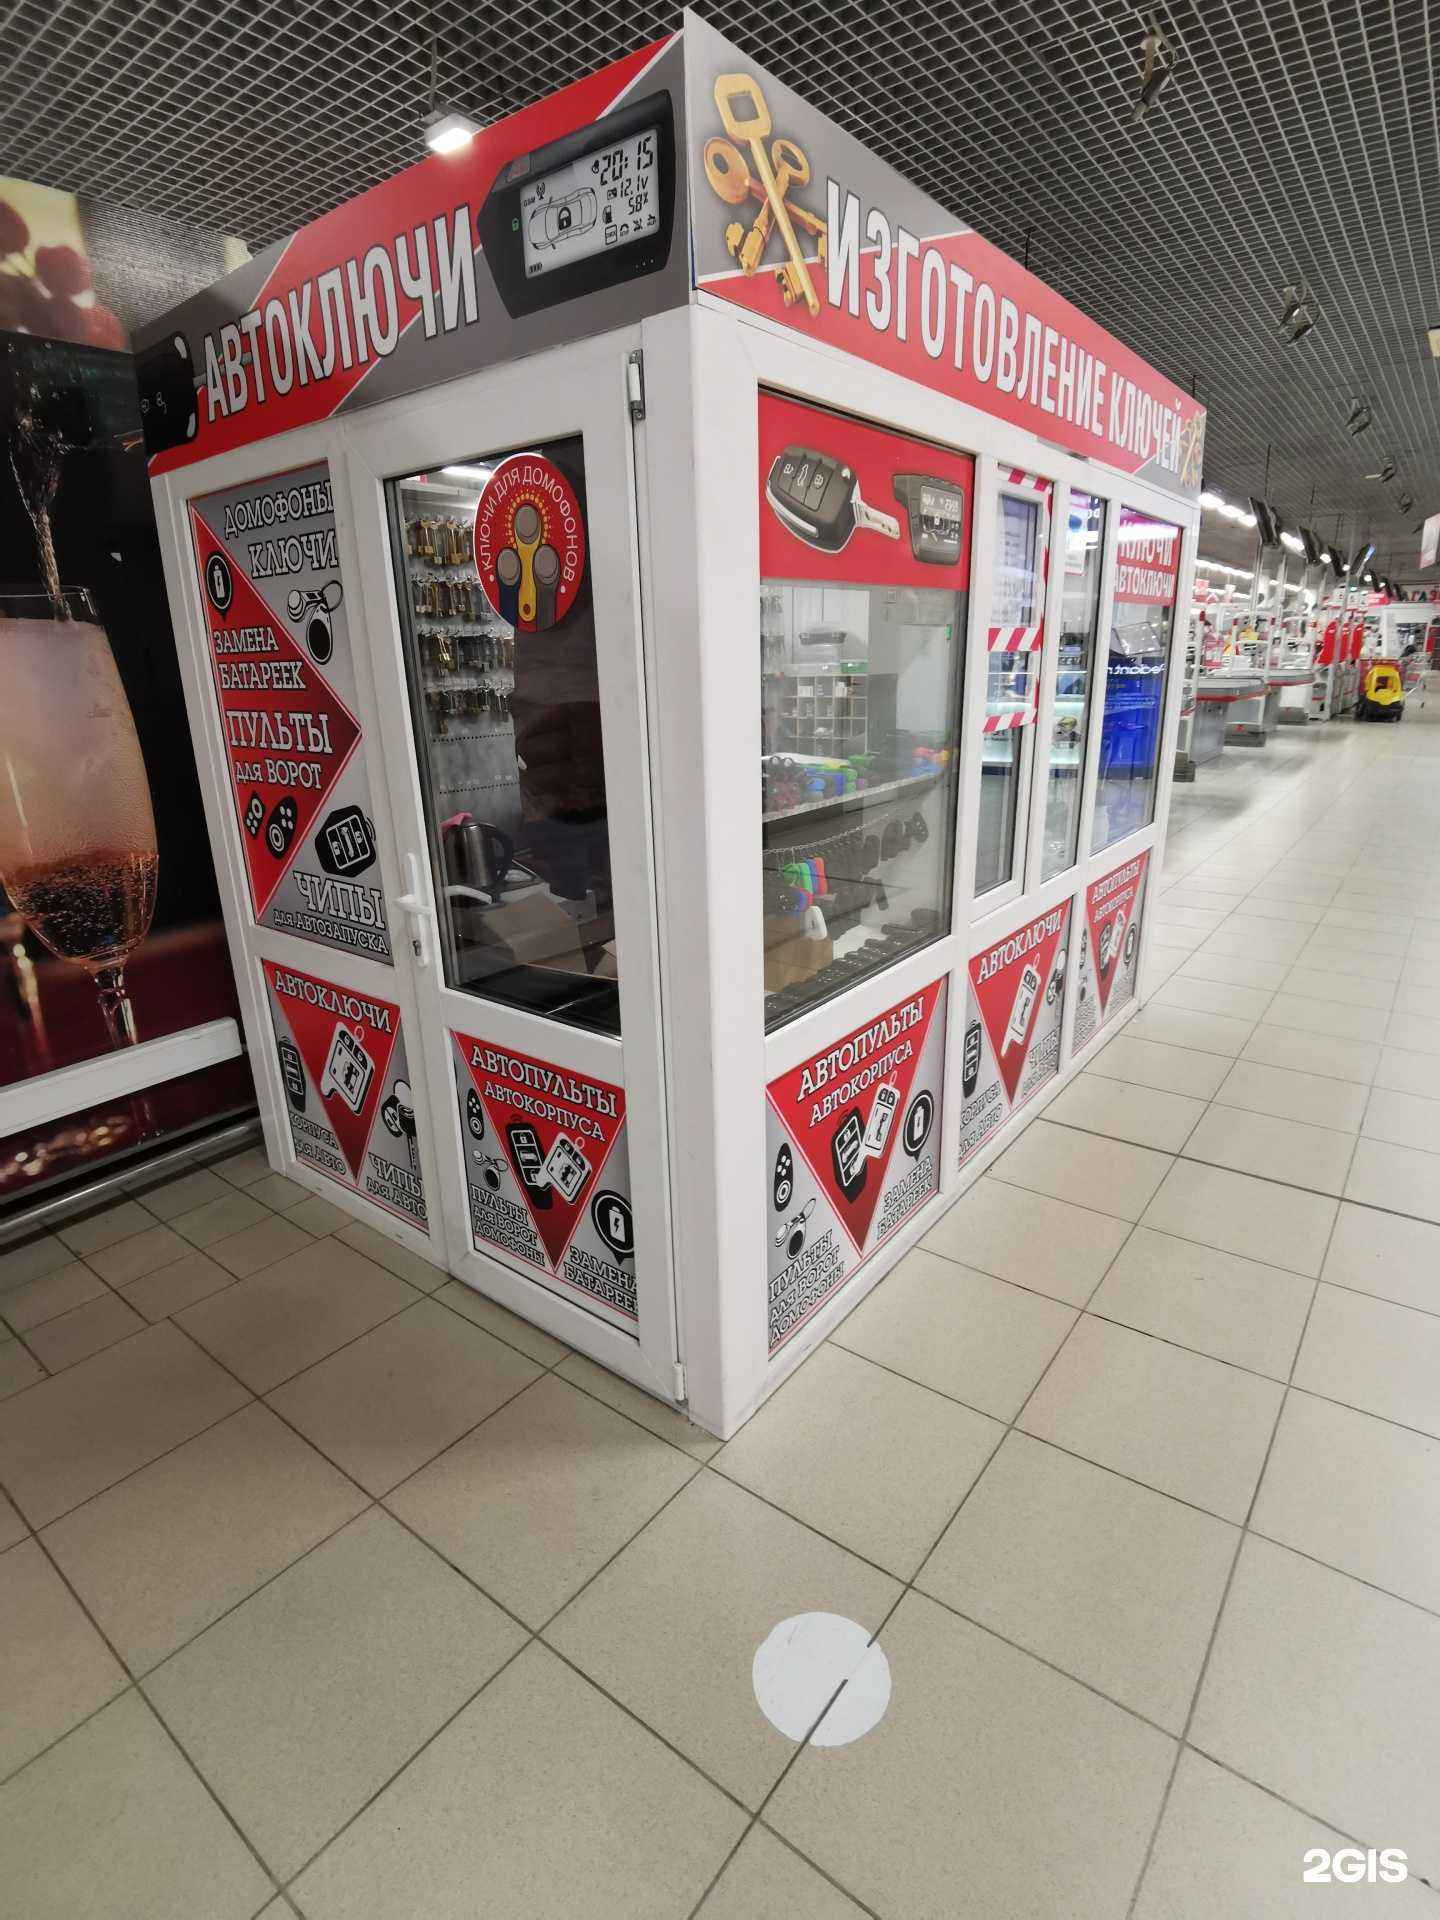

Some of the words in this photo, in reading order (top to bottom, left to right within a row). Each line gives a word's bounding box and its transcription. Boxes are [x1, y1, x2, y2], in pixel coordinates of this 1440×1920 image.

[203, 203, 480, 422] АВТОКЛЮЧИ
[826, 177, 1106, 437] ИЗГОТОВЛЕНИЕ
[1109, 370, 1182, 474] КЛЮЧЕЙ
[224, 479, 335, 539] ДОМОФОНЫ
[480, 496, 498, 571] КЛЮЧИ
[494, 467, 521, 502] ДЛЯ
[522, 466, 578, 582] ДОМОФОНОВ
[248, 528, 339, 579] КЛЮЧИ
[212, 626, 279, 654] ЗАМЕНА
[218, 660, 307, 690] БАТАРЕЕК
[226, 710, 333, 754] ПУЛЬТЫ
[265, 759, 323, 789] ВОРОТ
[293, 871, 386, 930] ЧИПЫ
[296, 913, 389, 955] АВТОЗАПУСКА
[976, 908, 1063, 985] АВТОКЛЮЧИ
[275, 970, 392, 1033] АВТОКЛЮЧИ
[797, 997, 924, 1102] АВТОПУЛЬТЫ
[470, 1045, 618, 1118] АВТОПУЛЬТЫ
[484, 1080, 607, 1143] АВТОКОРПУСА
[809, 1039, 914, 1128] АВТОКОРПУСА
[470, 1183, 529, 1227] ПУЛЬТЫ
[496, 1212, 537, 1246] ВОРОТ
[475, 1217, 545, 1266] ДОМОФОНЫ
[769, 1229, 833, 1303] ПУЛЬТЫ
